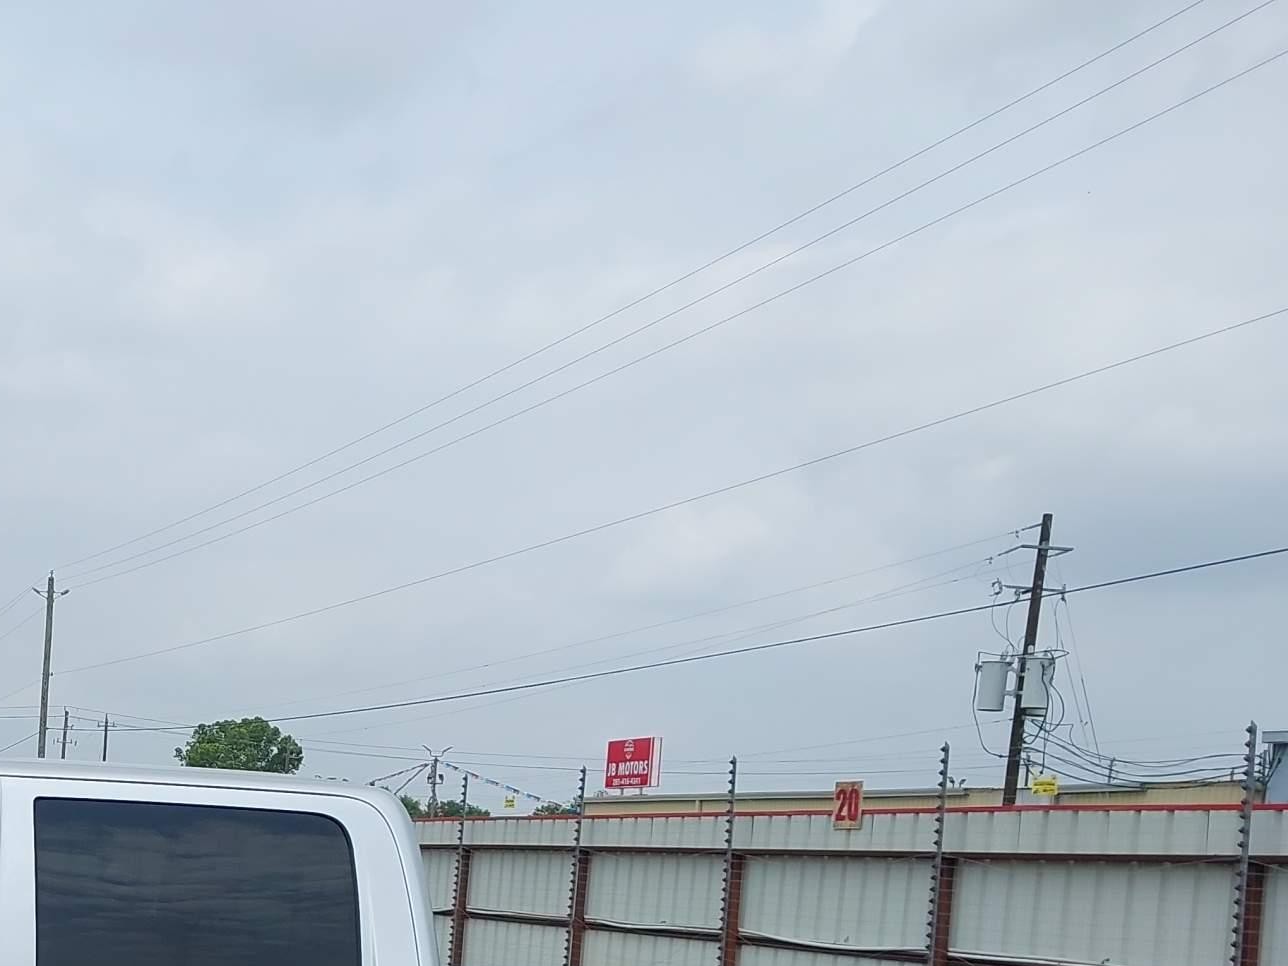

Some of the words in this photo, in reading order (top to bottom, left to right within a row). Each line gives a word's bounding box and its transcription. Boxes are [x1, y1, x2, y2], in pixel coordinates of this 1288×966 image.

[607, 762, 617, 777] JB
[617, 760, 649, 776] MOTORS
[835, 788, 860, 821] 20
